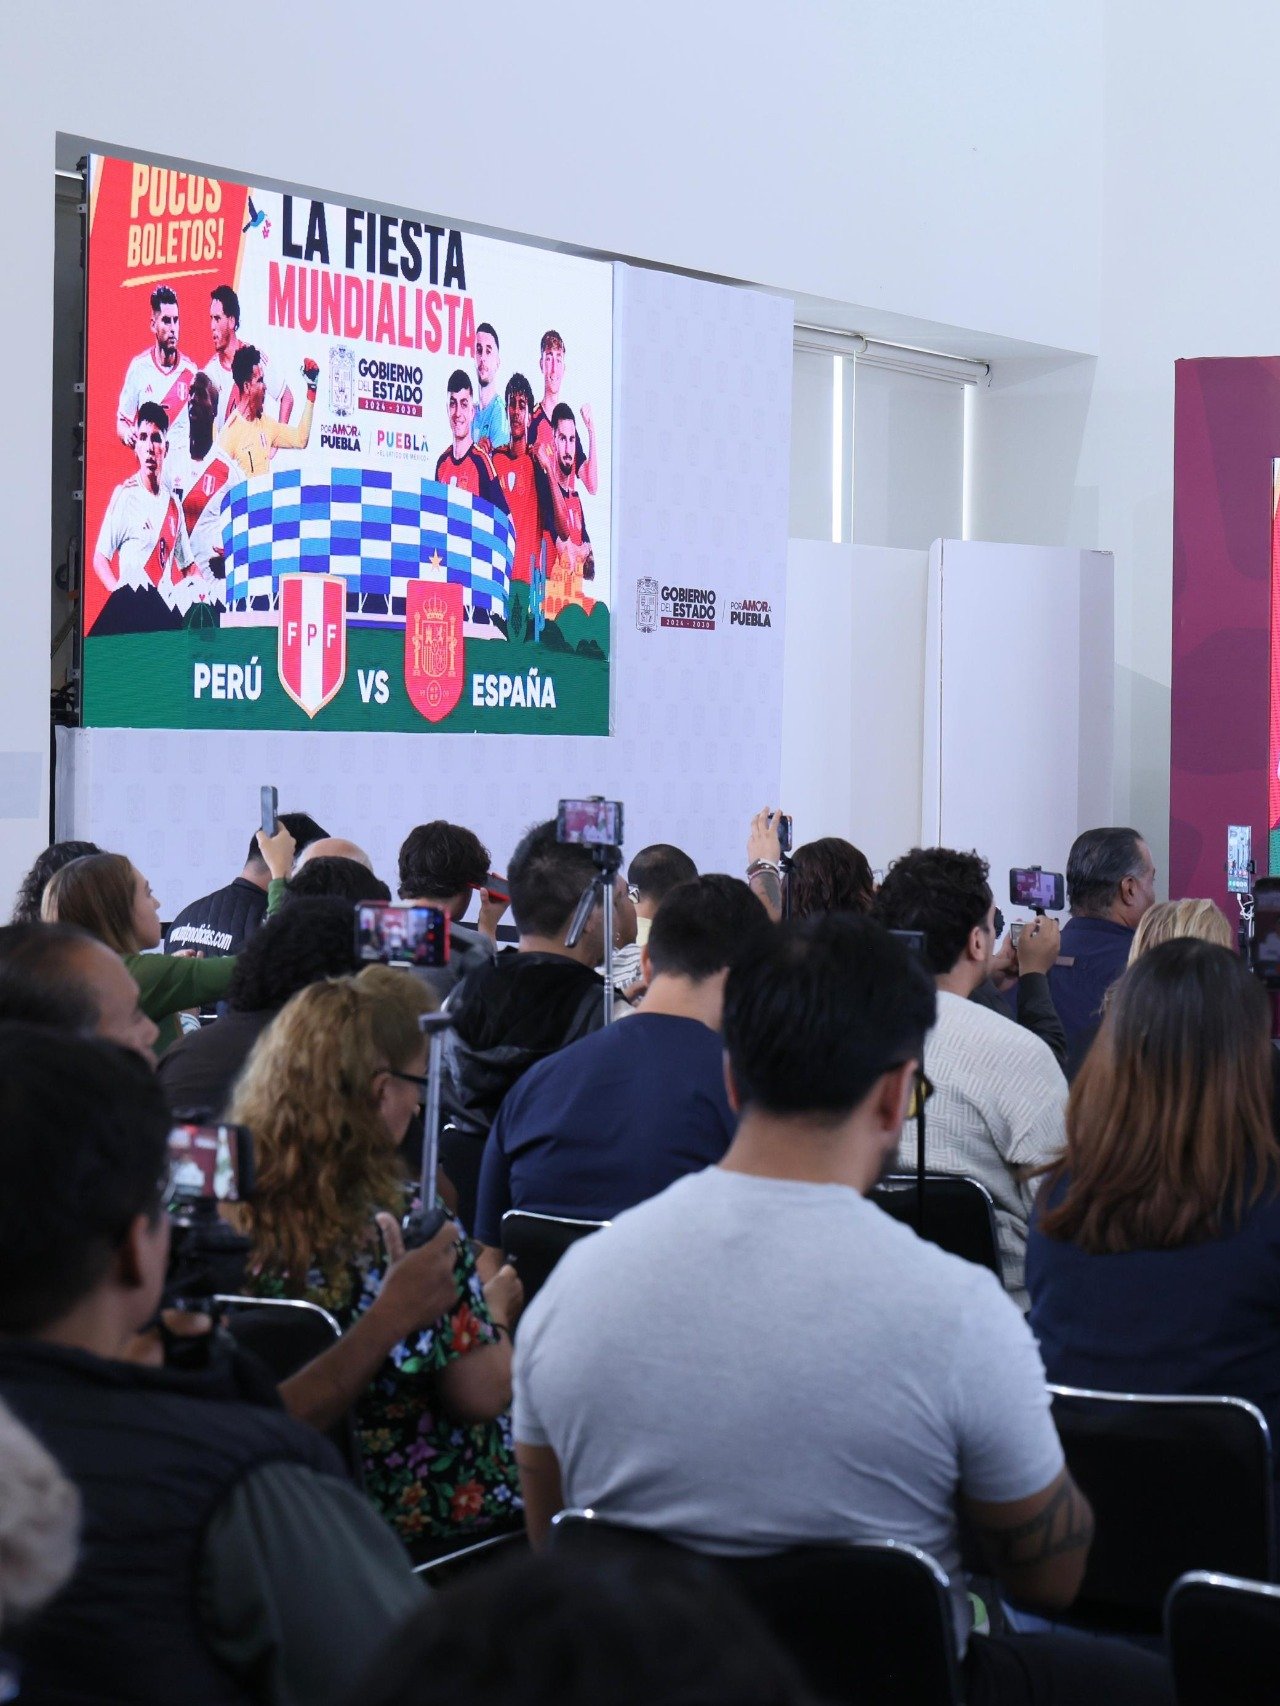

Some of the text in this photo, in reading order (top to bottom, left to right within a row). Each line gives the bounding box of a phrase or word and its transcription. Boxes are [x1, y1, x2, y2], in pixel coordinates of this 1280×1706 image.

[127, 217, 224, 268] BOLETOS!
[282, 194, 466, 290] LA FIESTA
[268, 261, 476, 358] MUNDIALISTA
[358, 358, 423, 385] GOBIERNO
[372, 380, 423, 404] ESTADO
[320, 434, 361, 452] PUEBLA
[377, 430, 429, 452] PUEBLA
[661, 586, 716, 605] GOBIERNO
[740, 600, 768, 612] AMOR
[661, 602, 716, 620] DEL ESTADO
[730, 611, 772, 627] PUEBLA
[194, 656, 557, 708] PERÚ VS ESPAÑA
